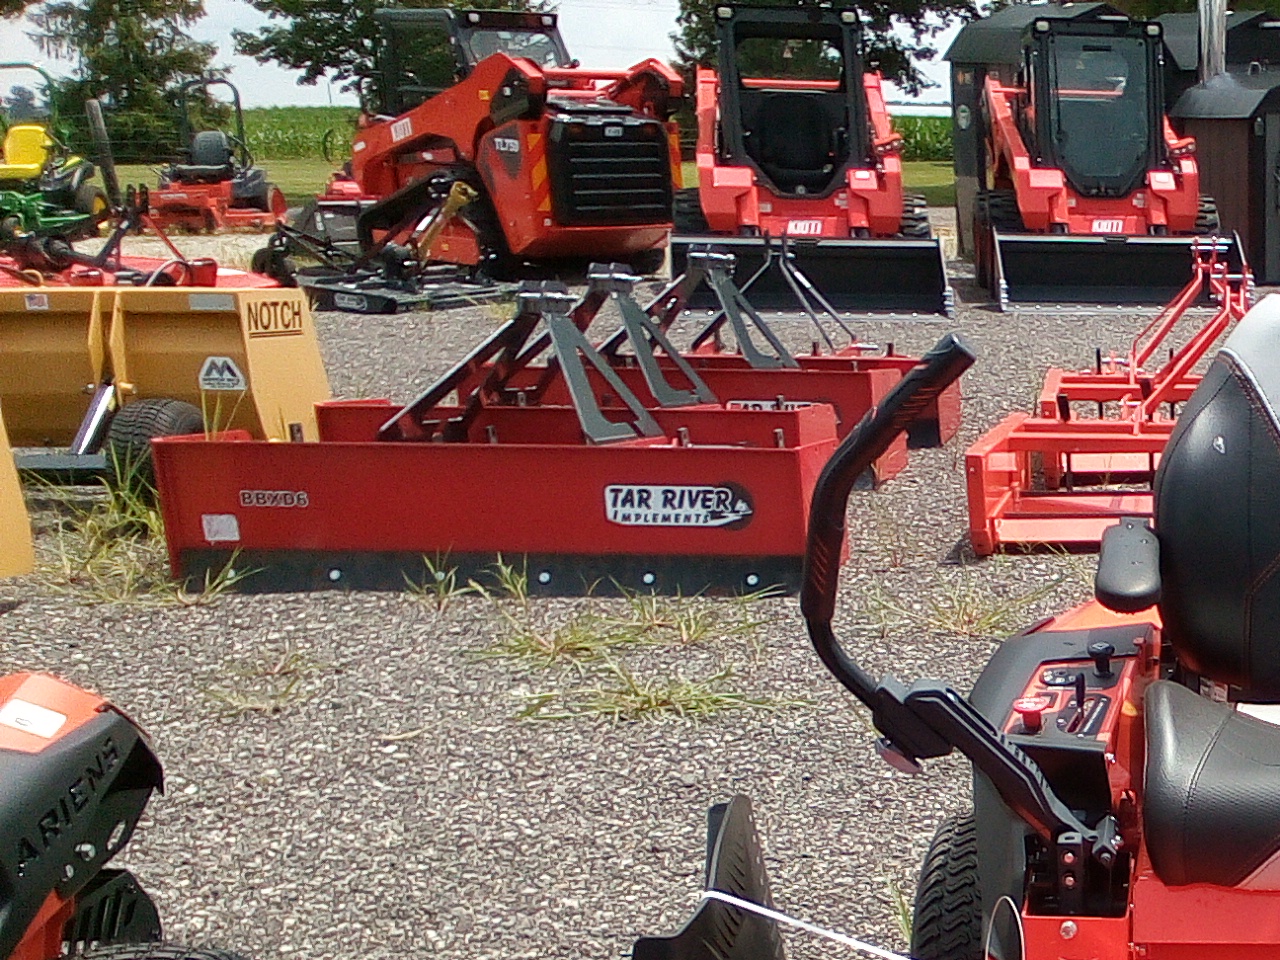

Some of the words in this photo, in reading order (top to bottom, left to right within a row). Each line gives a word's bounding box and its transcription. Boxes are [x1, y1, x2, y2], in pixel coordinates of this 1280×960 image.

[247, 300, 303, 331] NOTCH
[240, 490, 309, 507] BBXD6
[609, 488, 652, 510] TAR
[661, 488, 731, 511] RIVER
[612, 510, 711, 524] IMPLEMENTS
[17, 736, 121, 878] ARIENS
